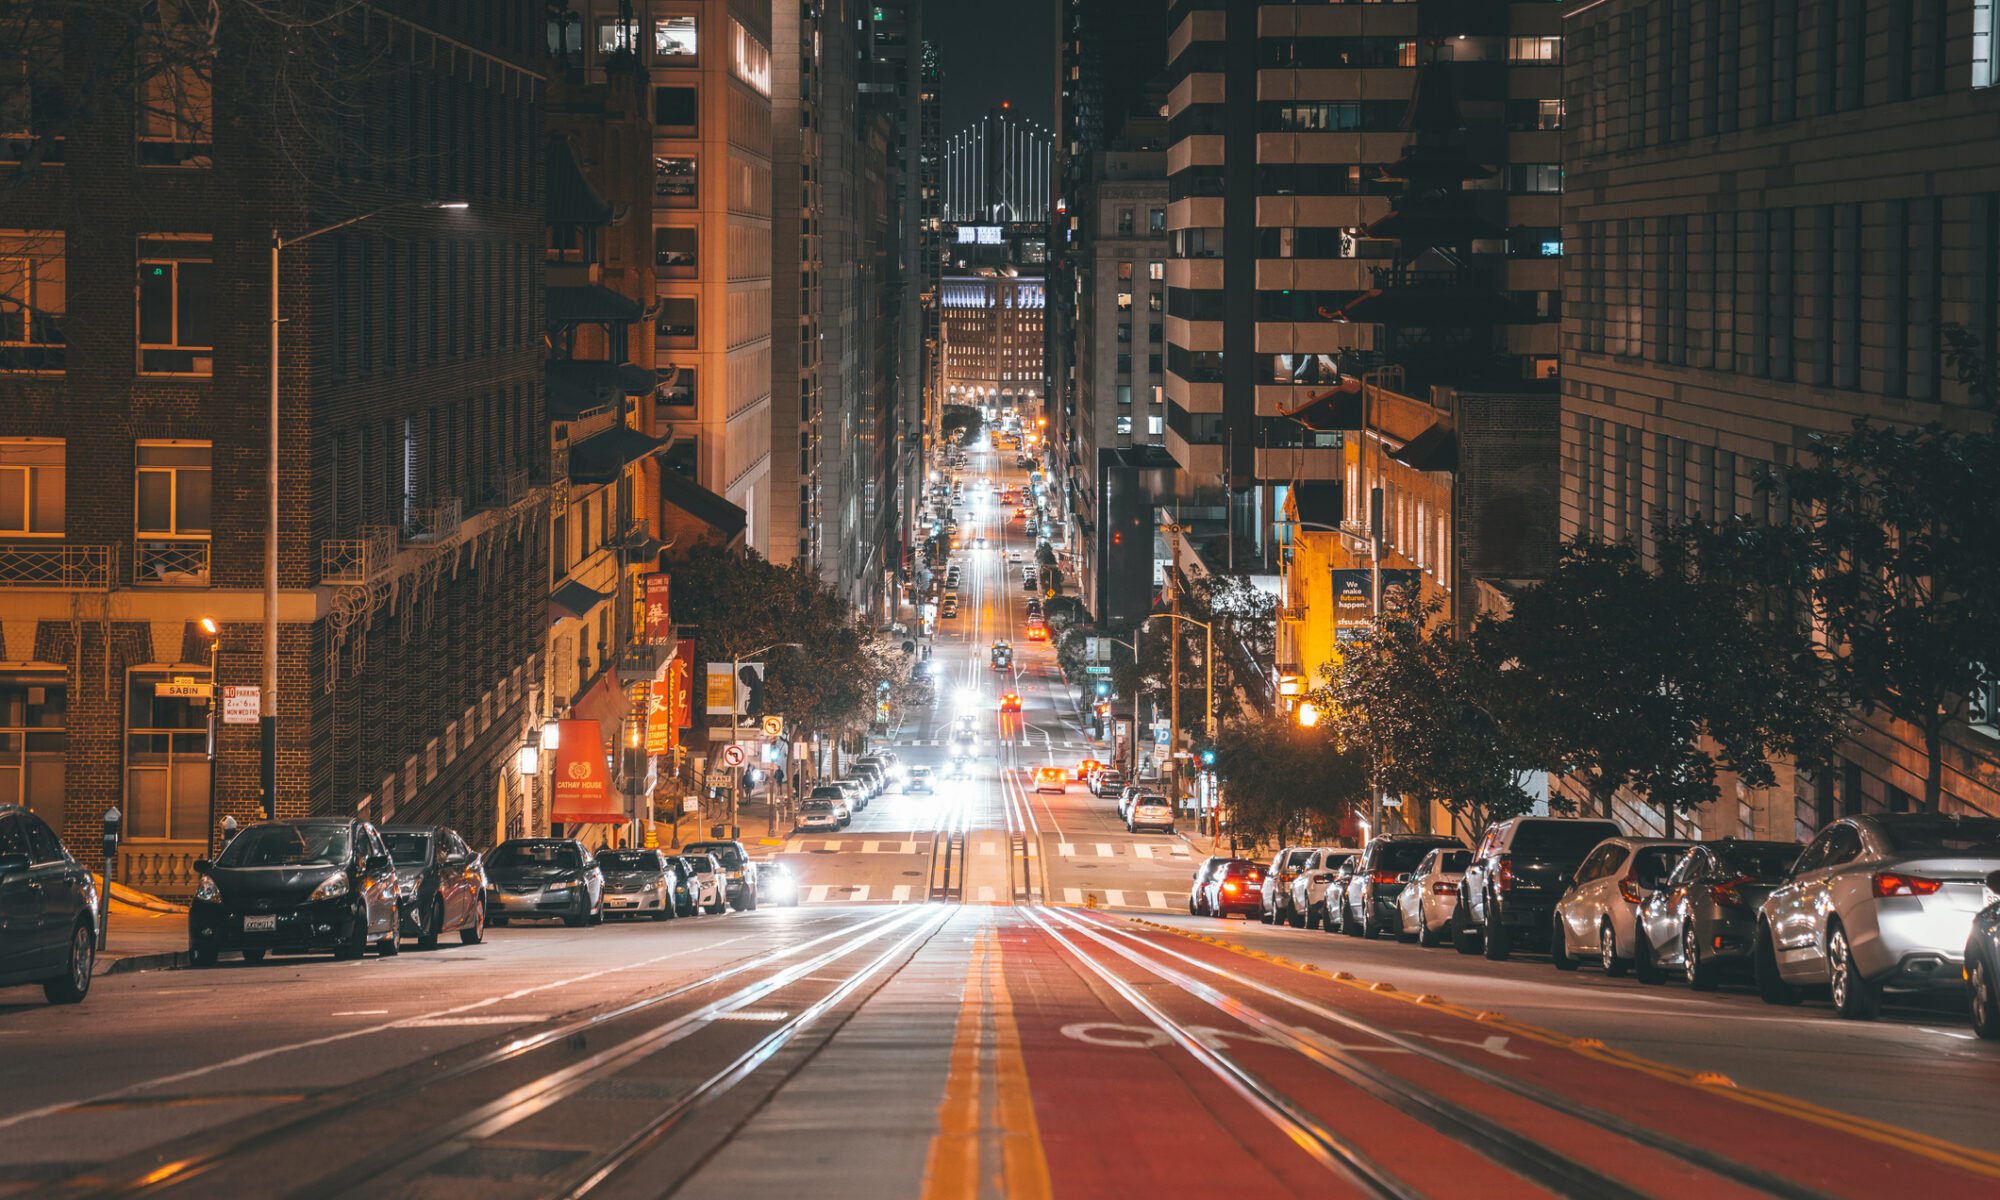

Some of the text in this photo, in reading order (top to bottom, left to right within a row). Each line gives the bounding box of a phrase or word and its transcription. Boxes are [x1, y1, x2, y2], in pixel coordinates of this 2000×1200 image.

[1340, 594, 1365, 602] futures
[1338, 601, 1367, 609] happen.
[1337, 618, 1369, 626] sfsu.edu
[169, 687, 199, 695] SABIN
[225, 687, 259, 698] NO PARKING
[557, 781, 602, 789] CATHAY HOUSE
